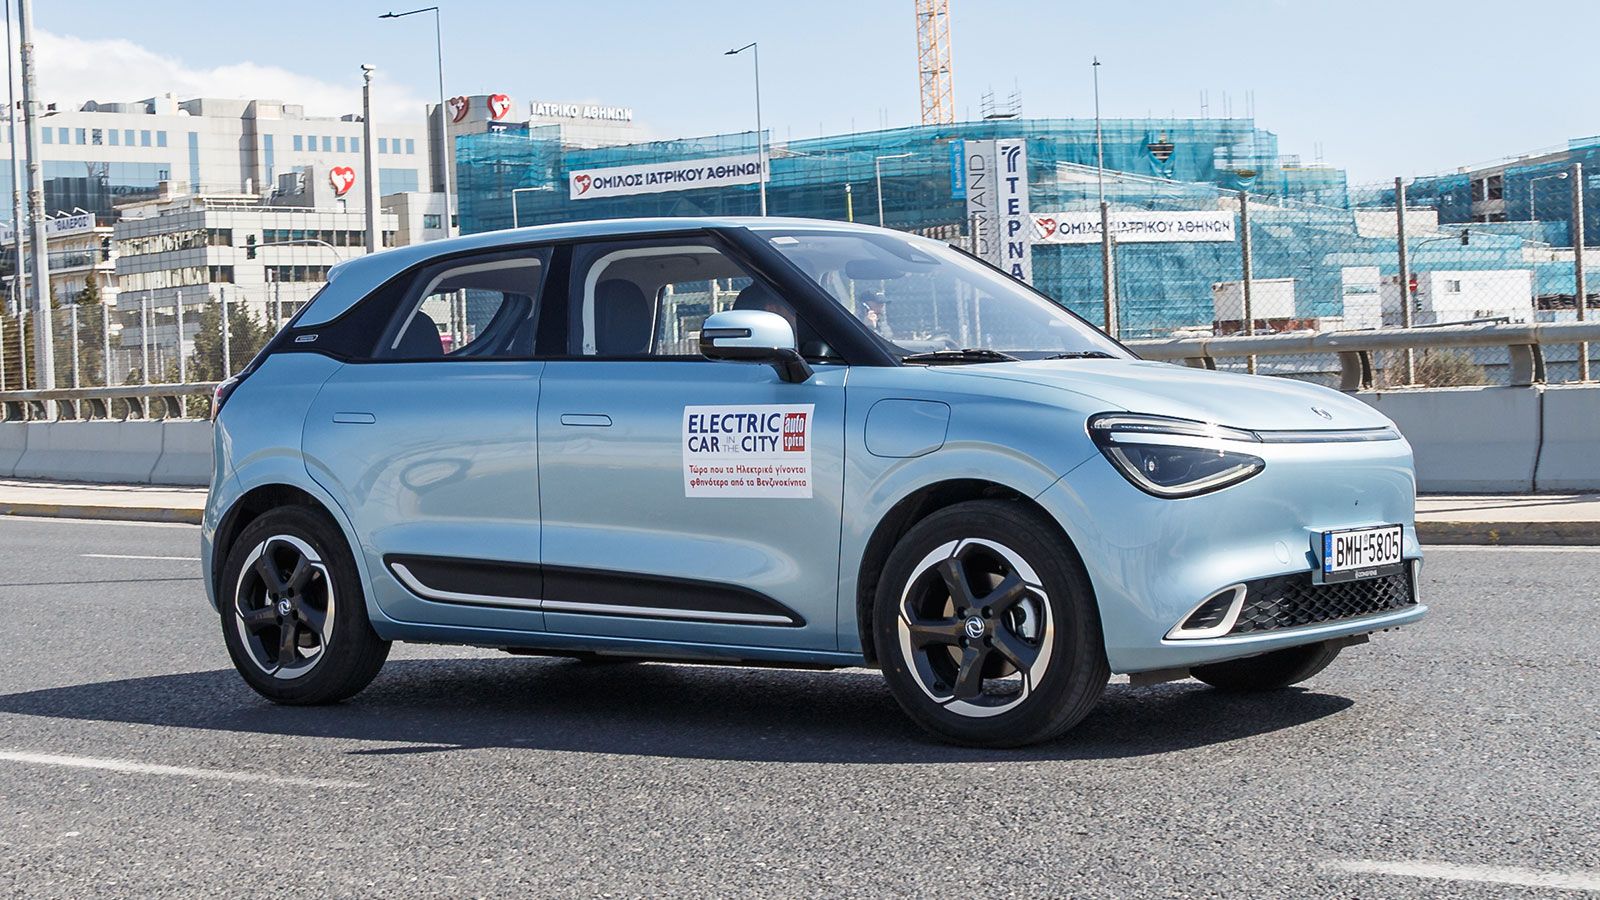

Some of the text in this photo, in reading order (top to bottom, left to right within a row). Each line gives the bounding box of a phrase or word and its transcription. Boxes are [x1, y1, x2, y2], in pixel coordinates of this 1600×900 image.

[532, 102, 632, 122] ΙΑΤΡΙΚΟ ΑΘΗΝΩΝ
[593, 161, 766, 190] ΟΜΙΛΟΣ ΙΑΤΡΙΚΟΥ ΑΘΗΝΩΝ
[1006, 177, 1026, 280] ΤΕΡΝΑ
[1117, 221, 1173, 234] ΙΑΤΡΙΚΟΥ
[1178, 219, 1230, 234] ΑΘΗΝΩΝ
[688, 412, 782, 434] ELECTRIC
[688, 436, 720, 453] CAR
[721, 445, 740, 453] THE
[741, 435, 779, 452] CITY
[689, 465, 708, 476] Τώρα
[736, 465, 773, 476] Ηλεκτρικά
[775, 465, 806, 476] γίνονται
[690, 477, 729, 488] φθηνότερα
[730, 478, 744, 487] από
[756, 477, 807, 488] Βενζινοκίνητα
[1336, 531, 1399, 567] BMH-5805
